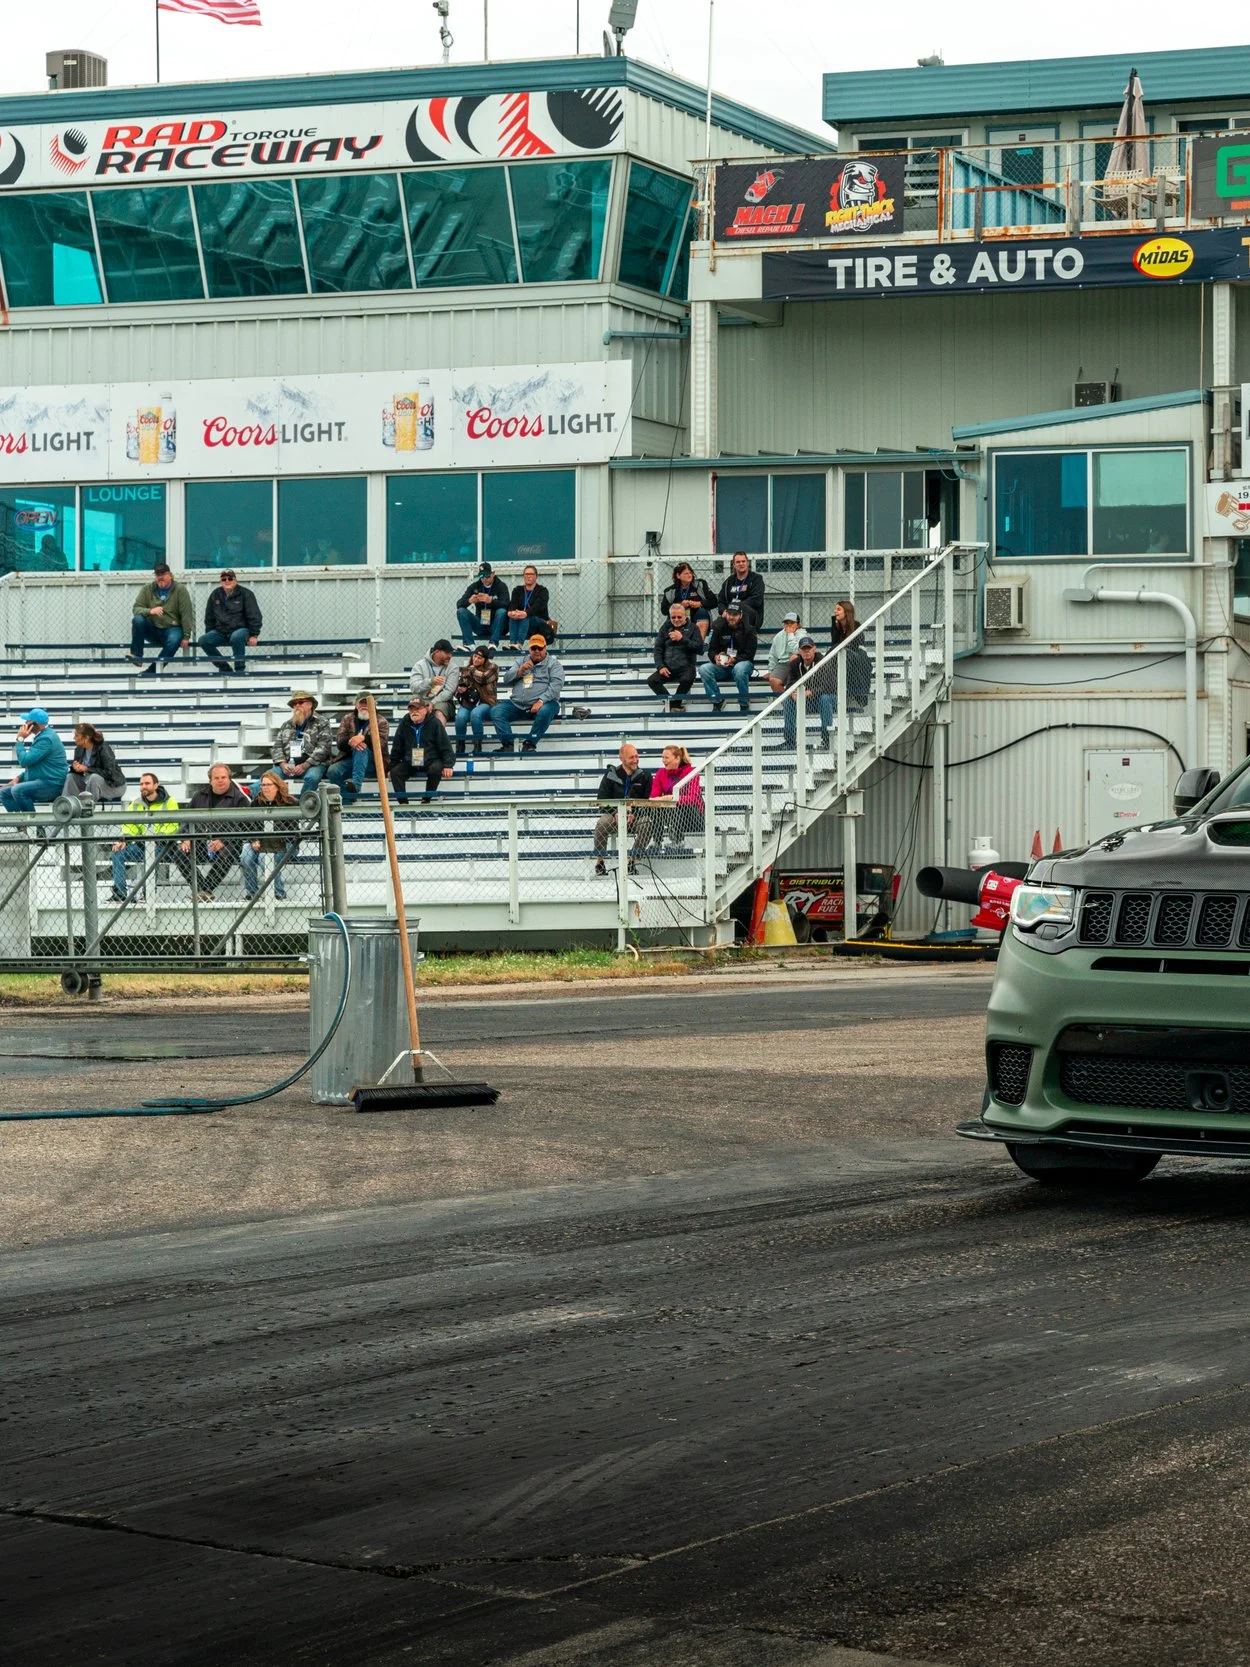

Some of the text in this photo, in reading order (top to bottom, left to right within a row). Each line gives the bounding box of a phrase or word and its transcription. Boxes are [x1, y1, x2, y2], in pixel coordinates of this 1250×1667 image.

[102, 119, 228, 150] RAD
[229, 127, 318, 142] TORQUE
[95, 135, 383, 176] RACEWAY
[733, 204, 792, 226] MACH
[830, 212, 894, 234] MECHANICAL
[734, 225, 757, 235] DIESEL
[756, 225, 780, 234] REPAIR
[828, 246, 1085, 290] TIRE & AUTO
[203, 415, 278, 448] Coors
[281, 421, 346, 445] LIGHT
[466, 406, 616, 440] Coors LIGHT
[32, 430, 95, 453] LIGHT
[89, 485, 161, 502] LOUNGE
[15, 511, 57, 525] OPEN
[817, 905, 839, 913] FUEL
